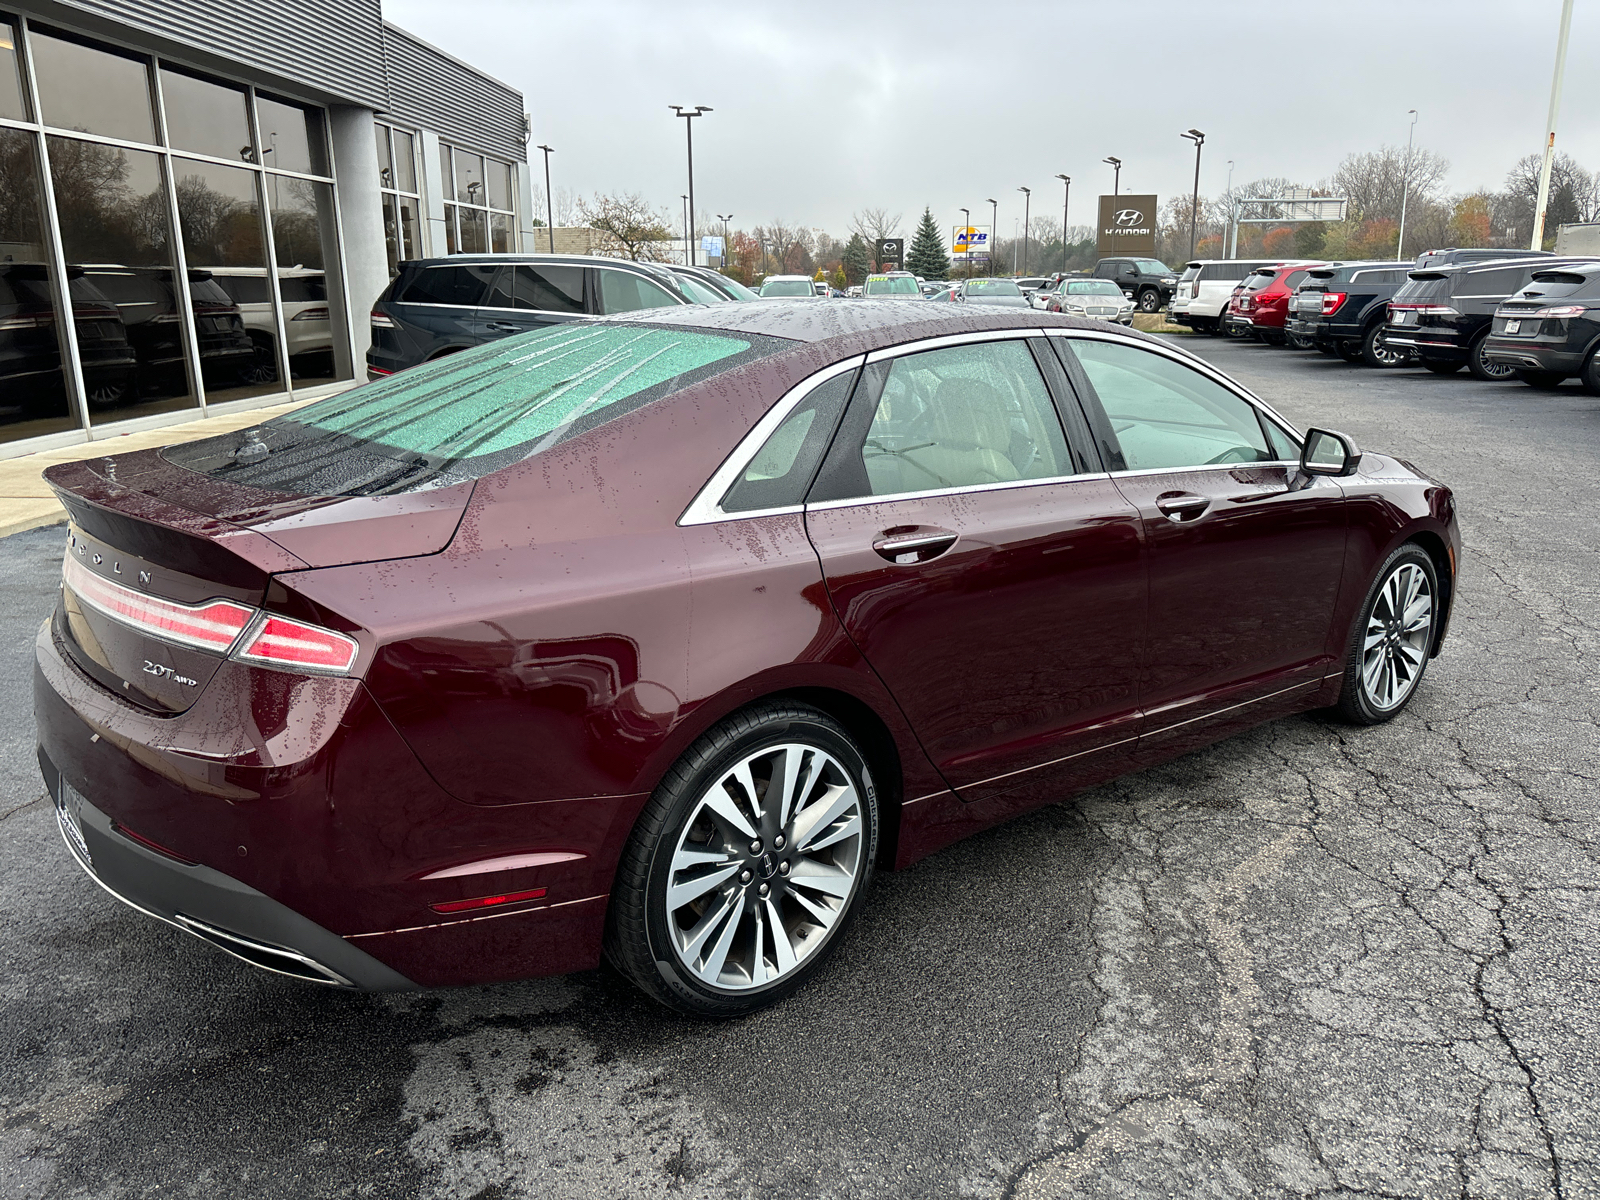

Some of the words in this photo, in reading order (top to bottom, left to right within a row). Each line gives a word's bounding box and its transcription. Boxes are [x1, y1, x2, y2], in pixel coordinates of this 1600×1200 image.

[957, 233, 988, 241] NTB
[1105, 228, 1150, 237] HYUNDAI
[173, 675, 197, 687] AWD
[866, 785, 877, 852] Cinturato
